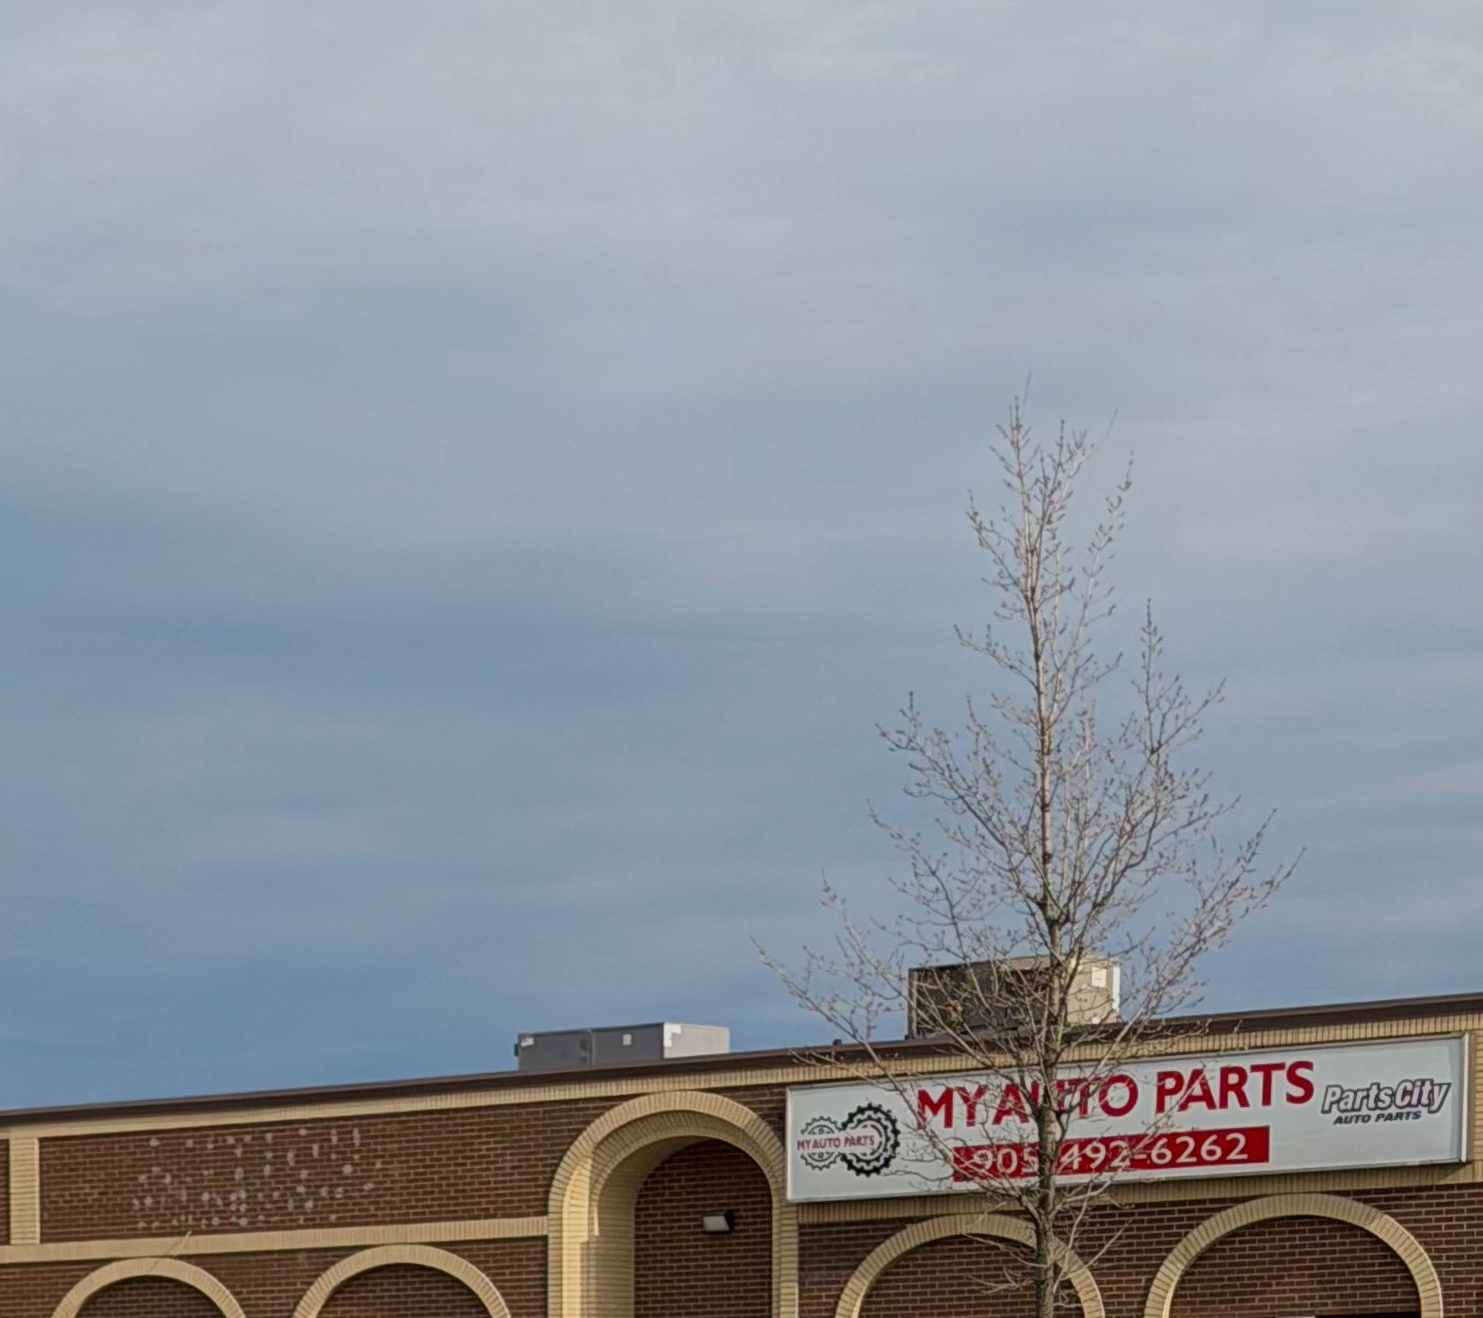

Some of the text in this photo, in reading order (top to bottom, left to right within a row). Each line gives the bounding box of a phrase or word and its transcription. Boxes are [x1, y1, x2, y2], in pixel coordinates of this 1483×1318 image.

[917, 1084, 988, 1131] MY
[1155, 1060, 1314, 1115] PARTS
[1333, 1110, 1422, 1125] AUTO PARTS
[843, 1134, 876, 1148] PARTS
